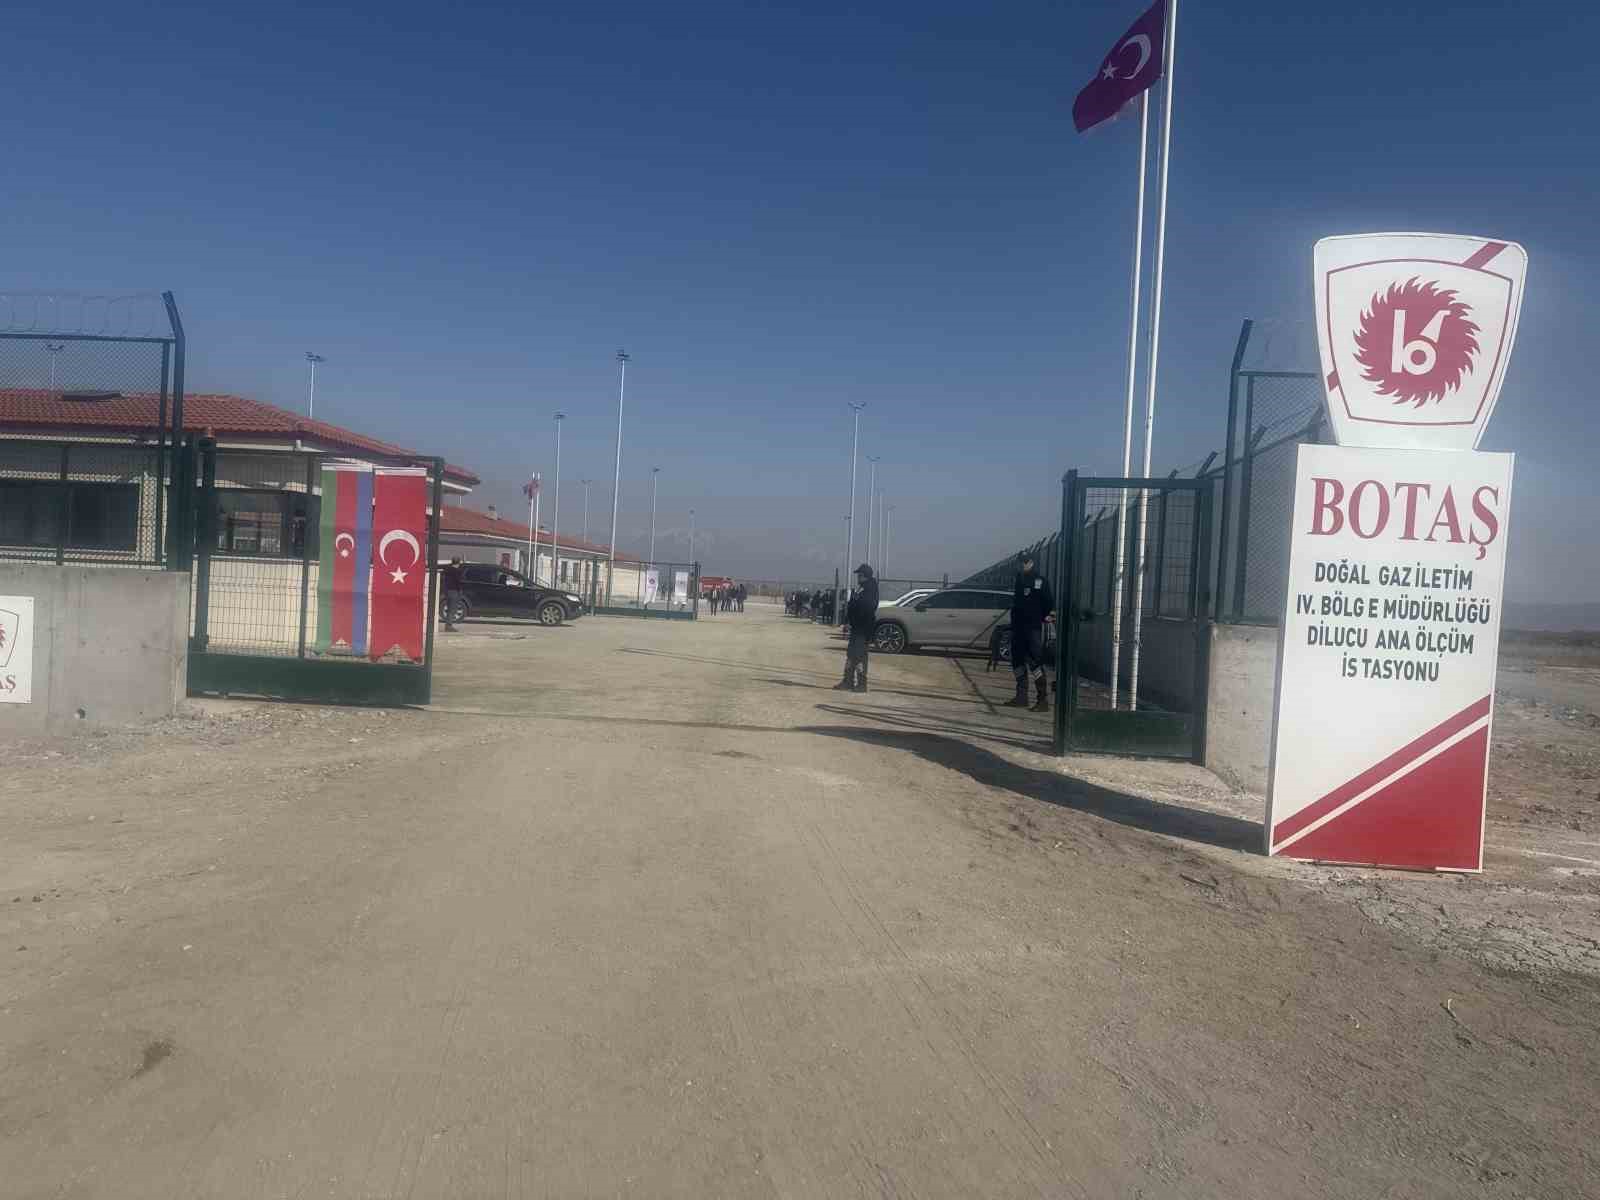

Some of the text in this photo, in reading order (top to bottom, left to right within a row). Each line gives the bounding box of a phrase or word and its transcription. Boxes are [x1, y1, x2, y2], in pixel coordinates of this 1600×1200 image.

[1307, 477, 1499, 560] BOTAŞ
[1315, 559, 1473, 590] DOĞAL GAZ İLETİM
[1296, 594, 1315, 615] IV.
[1383, 594, 1491, 624] MÜDÜRLÜĞÜ
[1307, 620, 1474, 657] DİLUCU ANA ÖLÇÜM
